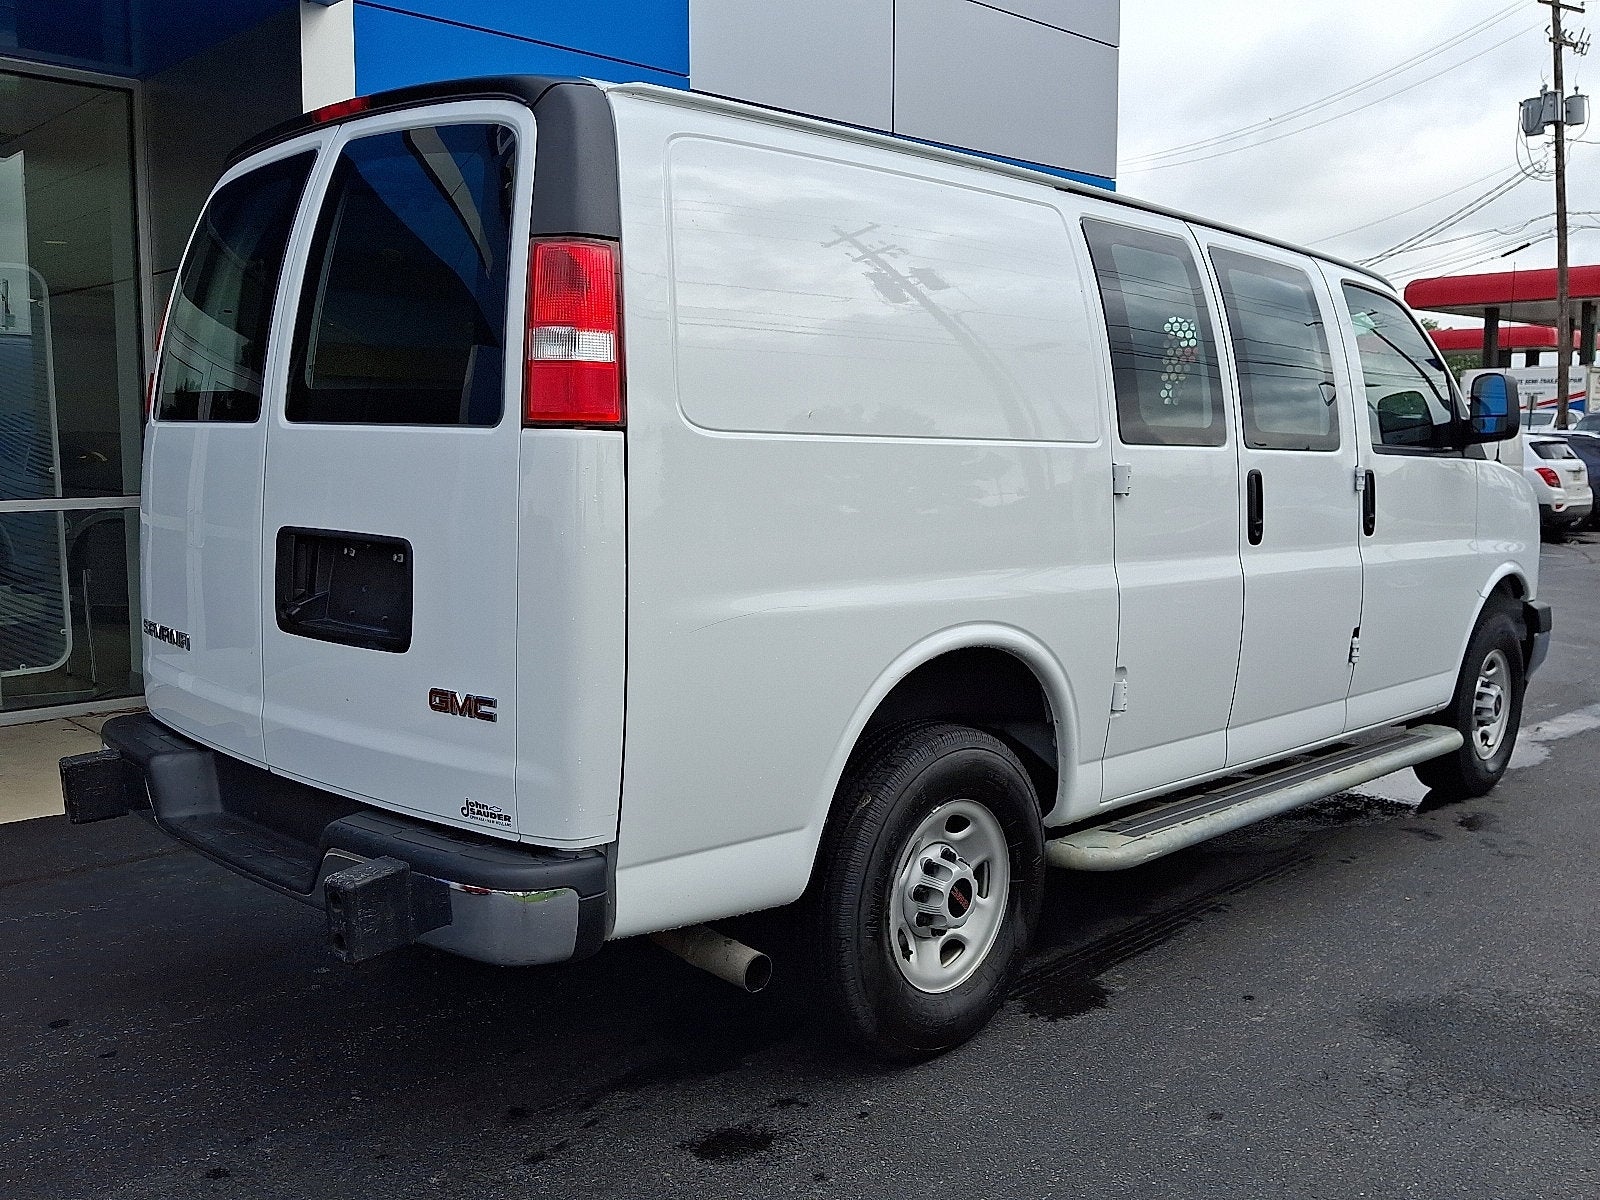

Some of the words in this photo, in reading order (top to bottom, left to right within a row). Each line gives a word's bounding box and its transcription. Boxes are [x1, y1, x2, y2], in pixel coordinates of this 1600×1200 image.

[428, 687, 498, 722] GMC
[461, 797, 489, 817] john
[470, 807, 512, 822] SAUDER
